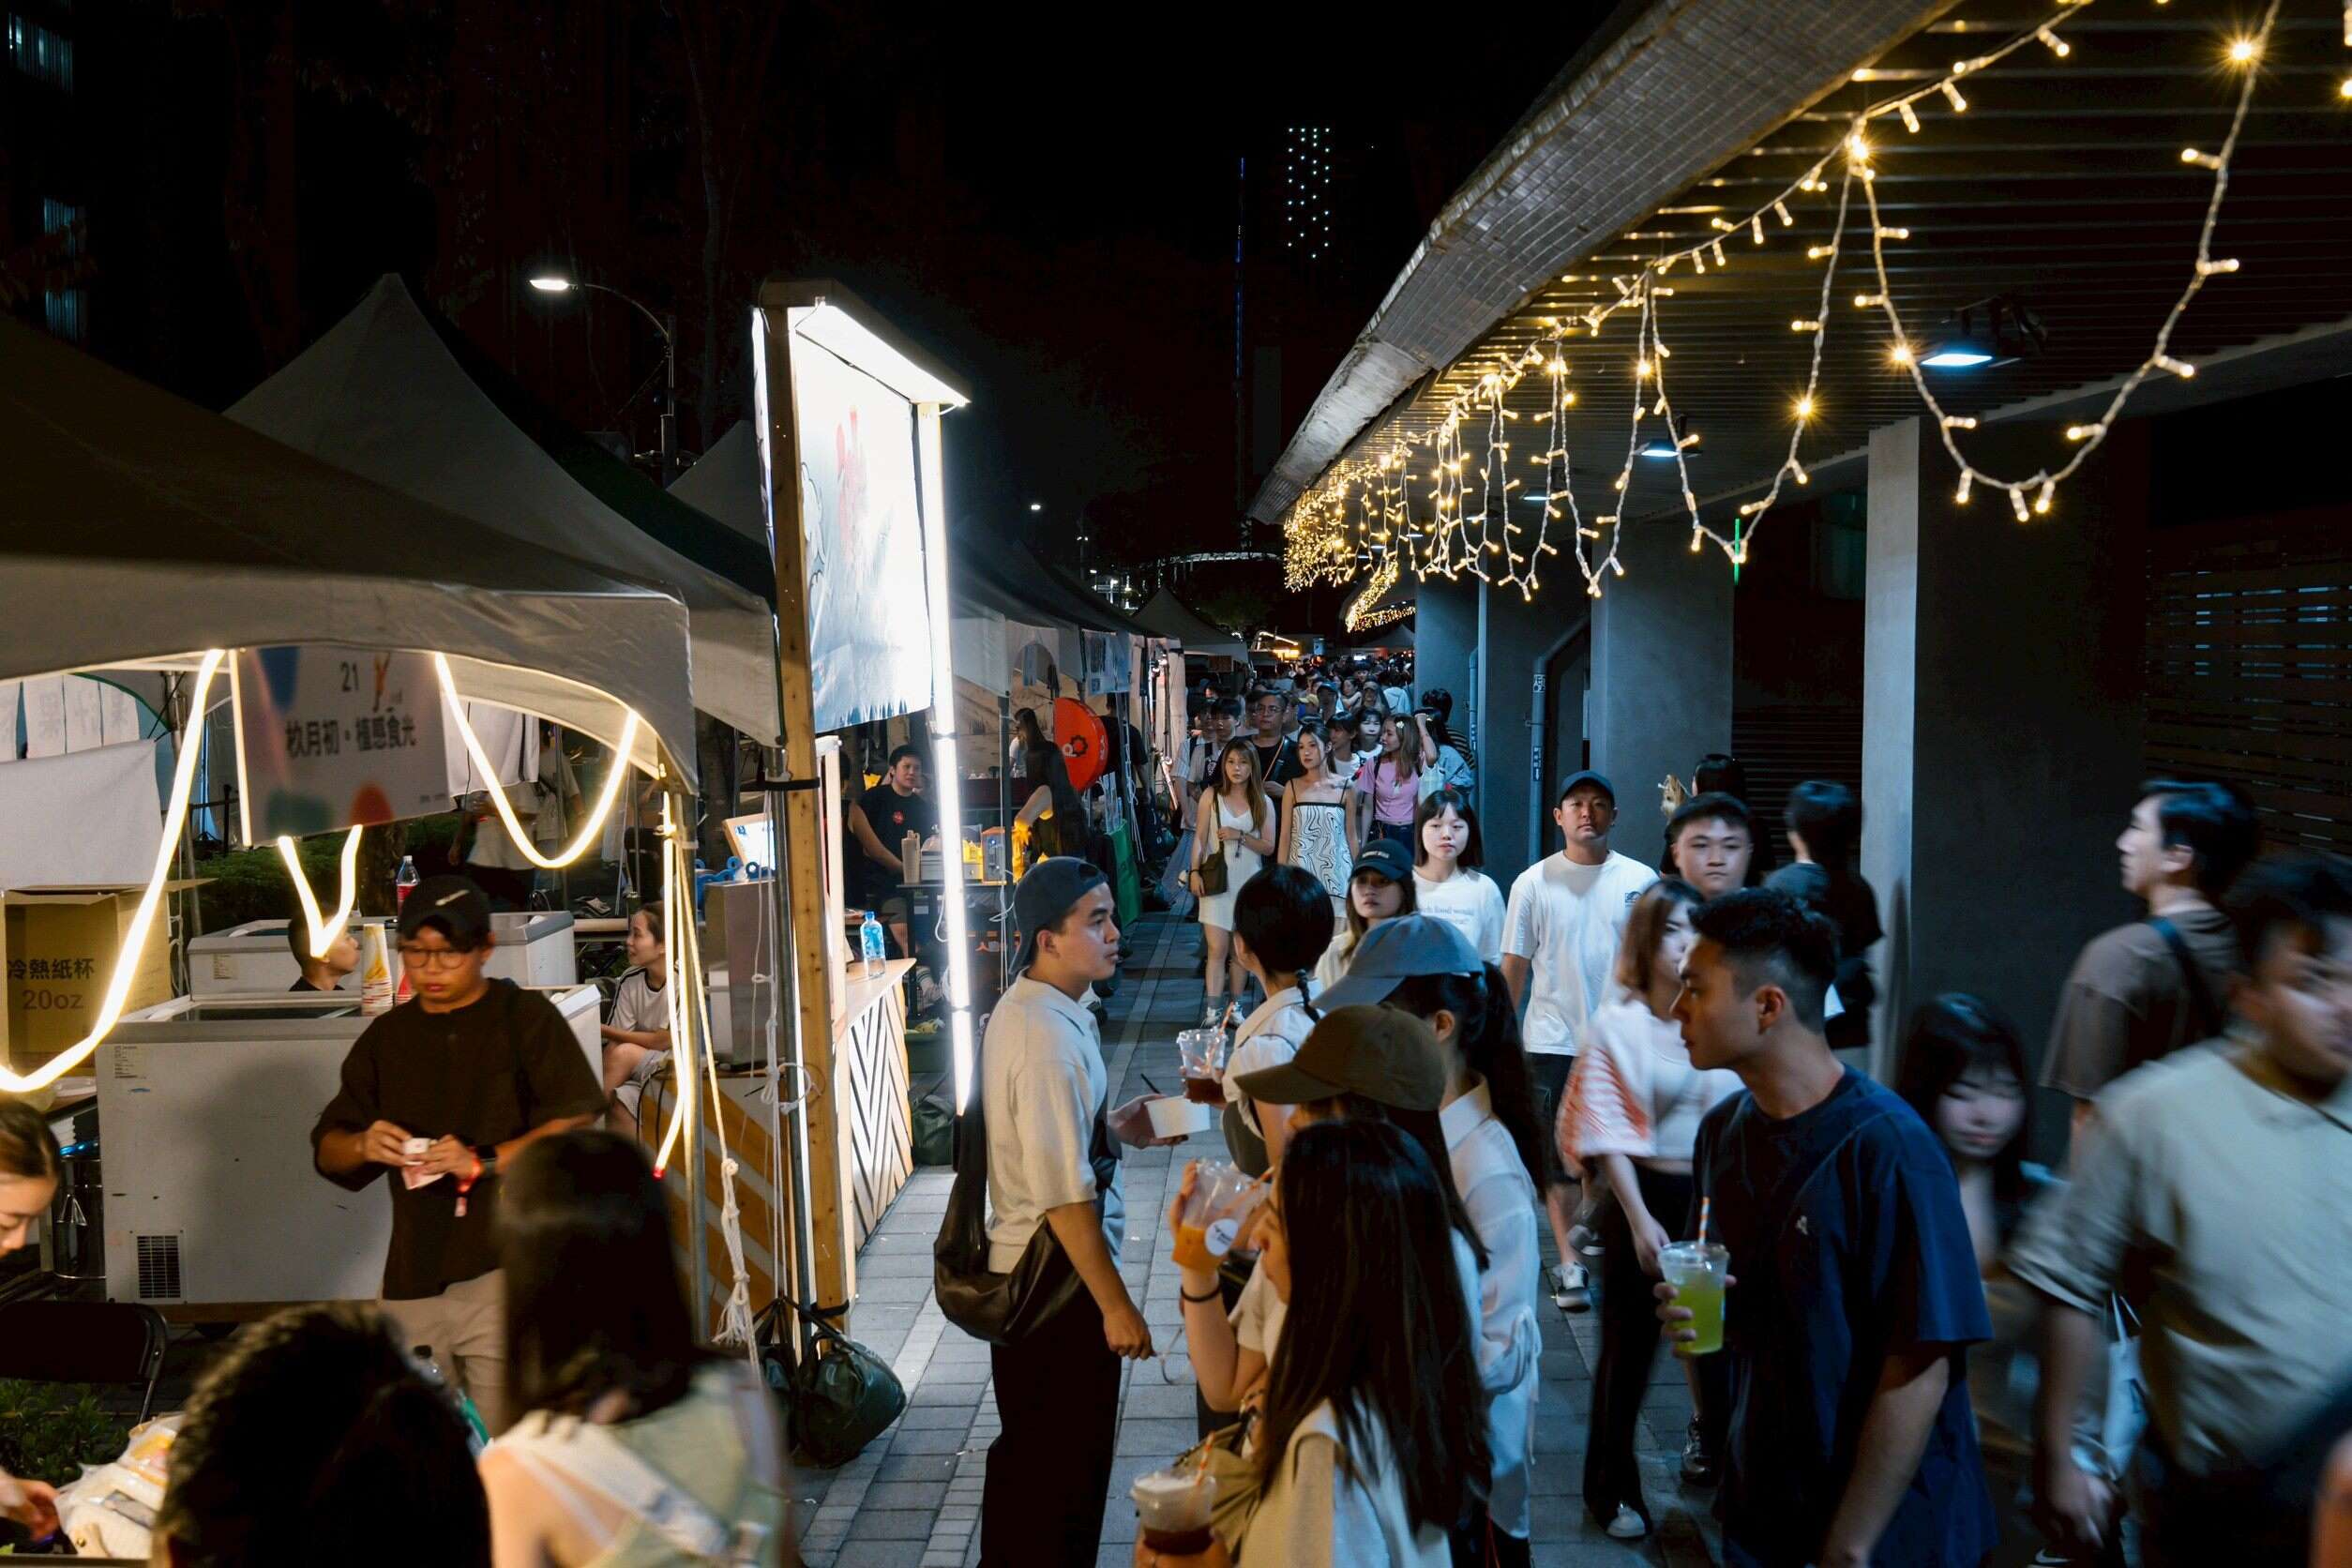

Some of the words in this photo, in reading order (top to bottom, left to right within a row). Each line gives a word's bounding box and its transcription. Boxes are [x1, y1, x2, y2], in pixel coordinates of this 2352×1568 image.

[340, 660, 359, 692] 21
[7, 958, 95, 980] 冷熱紙杯
[23, 989, 83, 1010] 20oz
